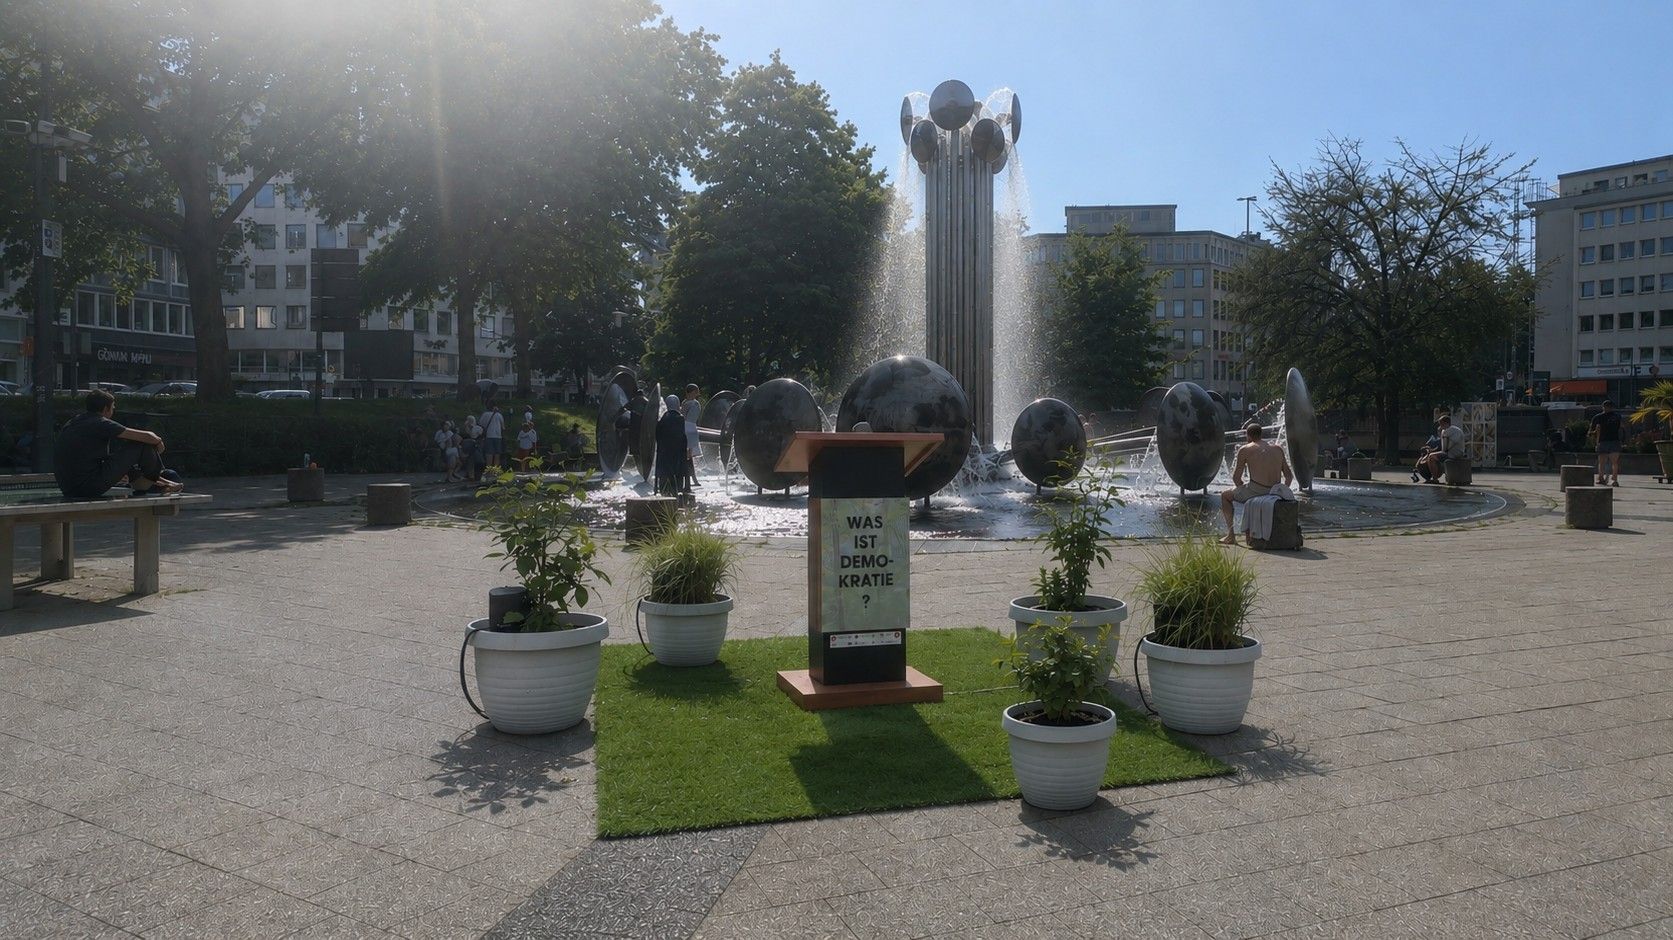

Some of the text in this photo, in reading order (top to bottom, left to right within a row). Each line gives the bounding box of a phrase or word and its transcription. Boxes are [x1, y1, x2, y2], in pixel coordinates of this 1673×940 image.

[847, 515, 883, 529] WAS
[854, 535, 878, 549] IST
[840, 555, 894, 569] DEMO-
[839, 573, 894, 588] KRATIE
[862, 594, 870, 609] ?
